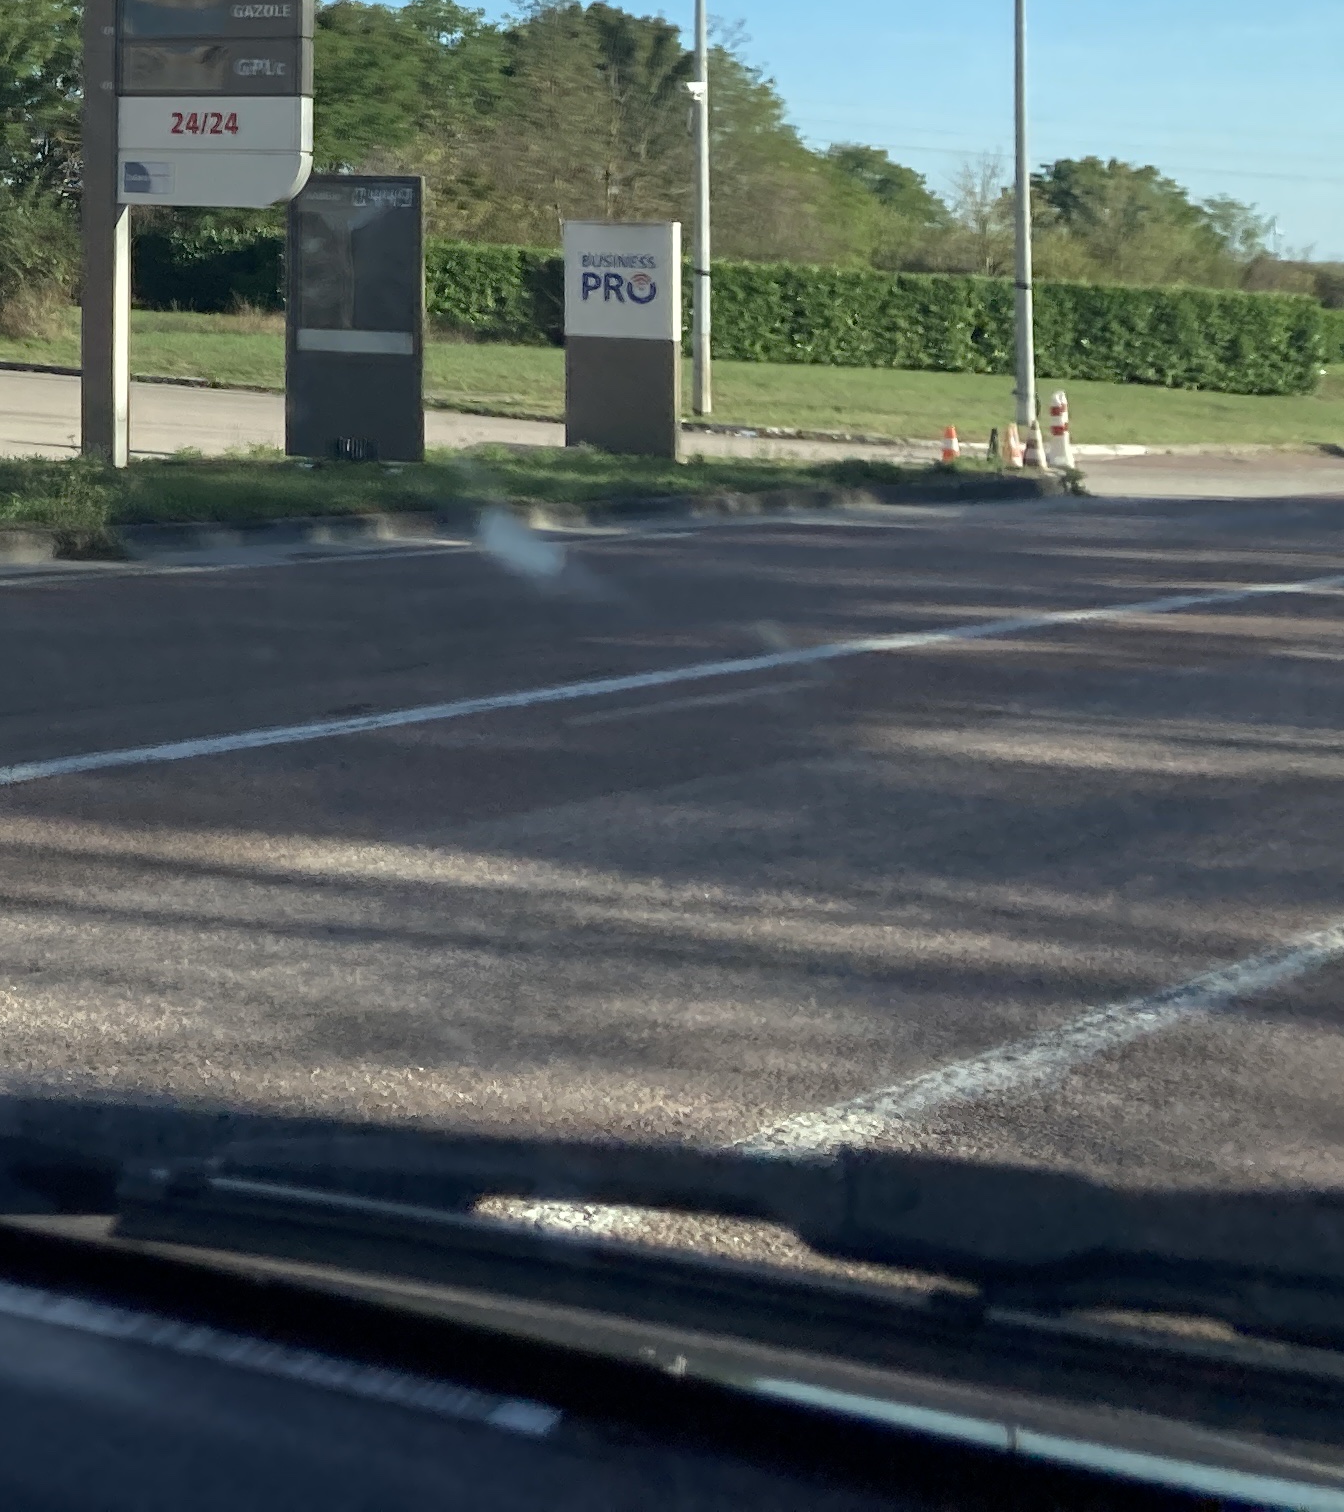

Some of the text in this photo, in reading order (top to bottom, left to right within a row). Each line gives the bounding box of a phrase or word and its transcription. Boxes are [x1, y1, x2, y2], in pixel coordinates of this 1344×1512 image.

[232, 4, 291, 18] GAZOLE
[171, 112, 238, 135] 24/24
[582, 254, 656, 269] BUSINESS
[582, 271, 657, 304] PRO
